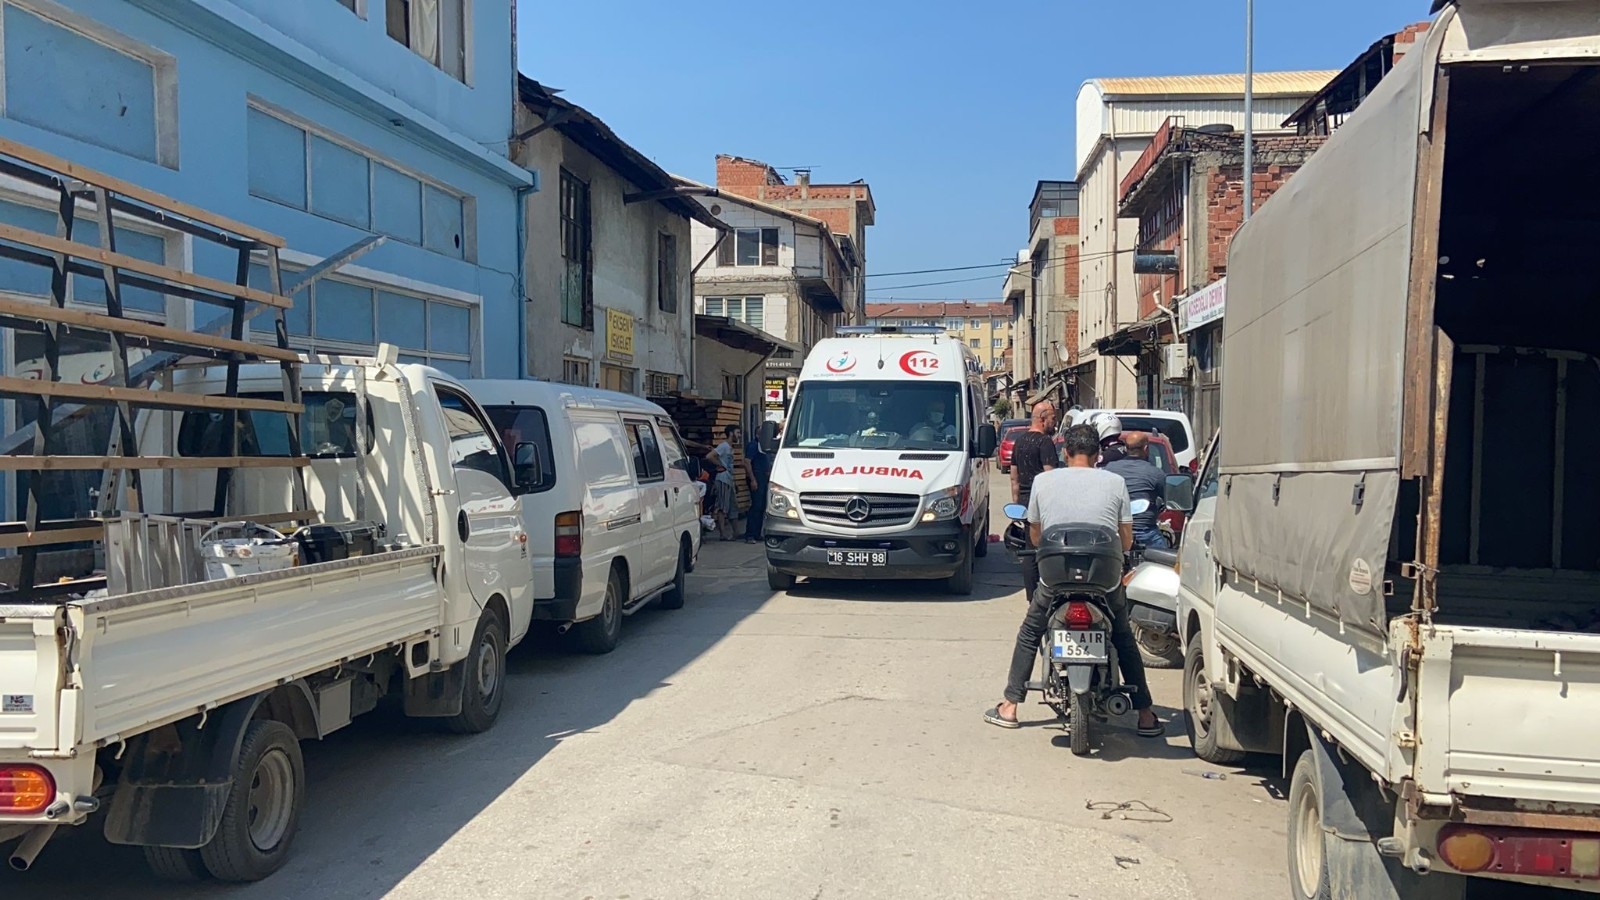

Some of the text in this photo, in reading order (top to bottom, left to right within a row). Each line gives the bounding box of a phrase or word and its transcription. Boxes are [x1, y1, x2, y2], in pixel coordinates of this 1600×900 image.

[910, 357, 939, 368] 112
[833, 552, 885, 563] 16 SHH 98
[1058, 632, 1103, 643] 16 AIR
[1067, 645, 1090, 656] 554
